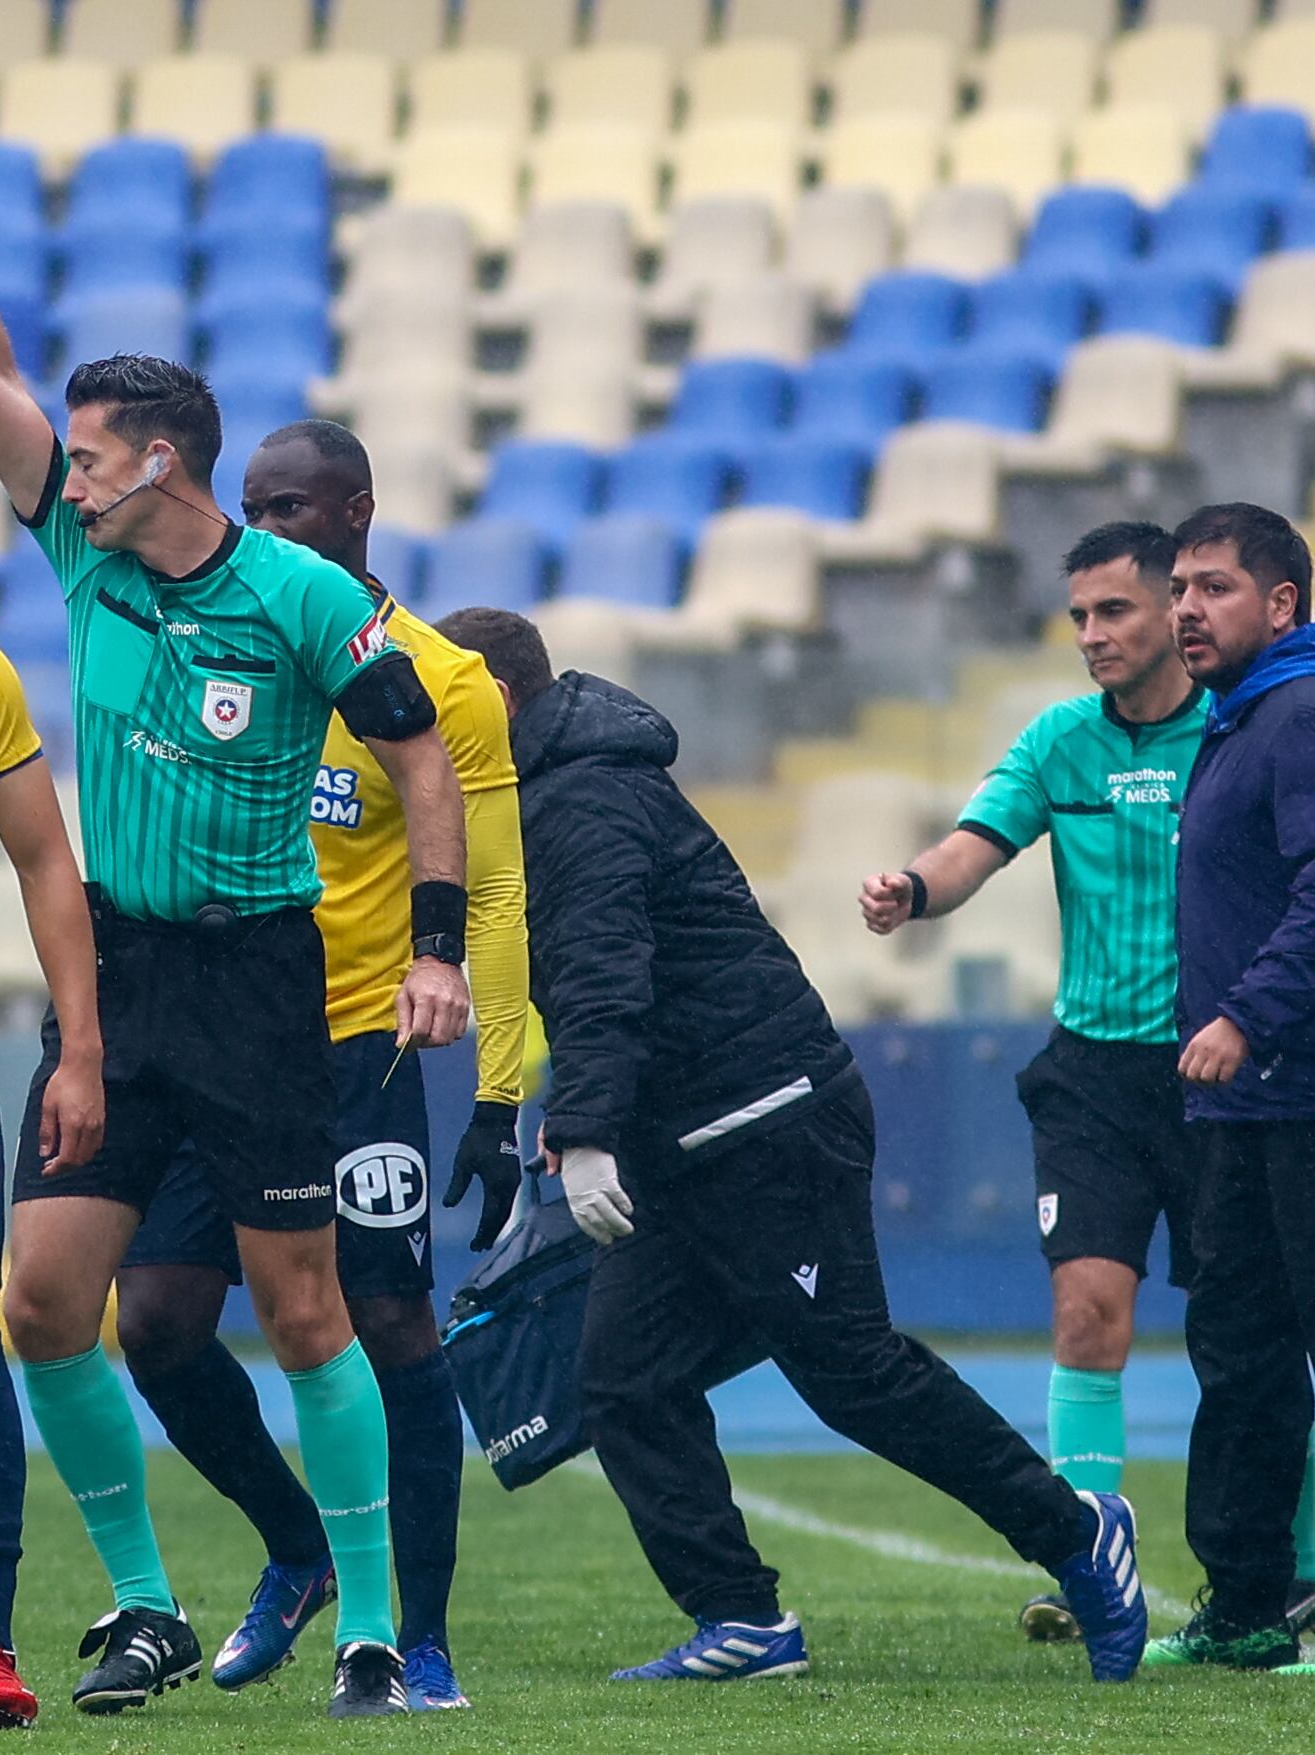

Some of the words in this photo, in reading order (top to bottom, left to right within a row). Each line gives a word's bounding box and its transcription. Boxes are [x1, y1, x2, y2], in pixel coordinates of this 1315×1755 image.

[1107, 767, 1177, 784] marathon
[263, 1184, 332, 1201] marathon
[352, 1157, 414, 1213] PF
